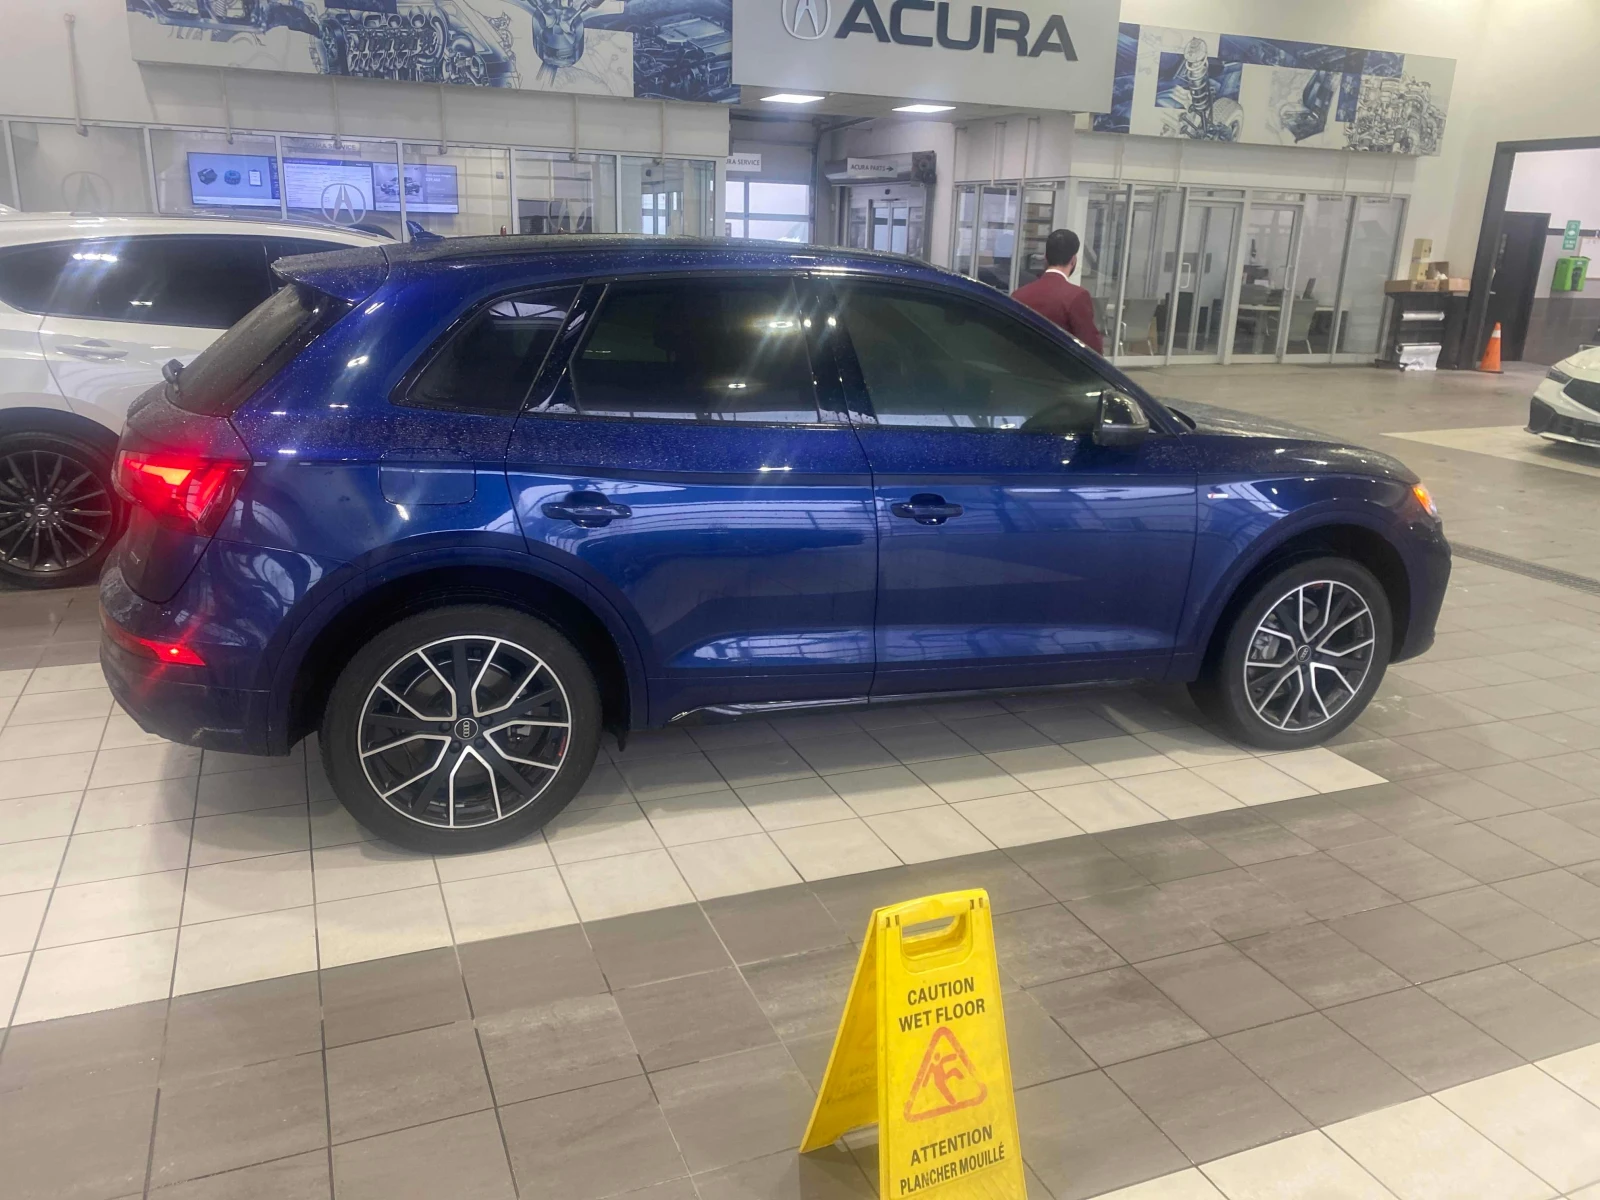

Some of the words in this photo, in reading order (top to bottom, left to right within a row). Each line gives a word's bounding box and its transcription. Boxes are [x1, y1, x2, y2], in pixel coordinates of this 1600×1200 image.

[834, 0, 1078, 61] ACURA
[907, 976, 975, 1006] CAUTION
[898, 1010, 932, 1032] WET
[936, 998, 985, 1023] FLOOR
[910, 1124, 993, 1167] ATTENTION
[900, 1161, 958, 1195] PLANCHER
[959, 1141, 1005, 1175] MOUILLÉ
